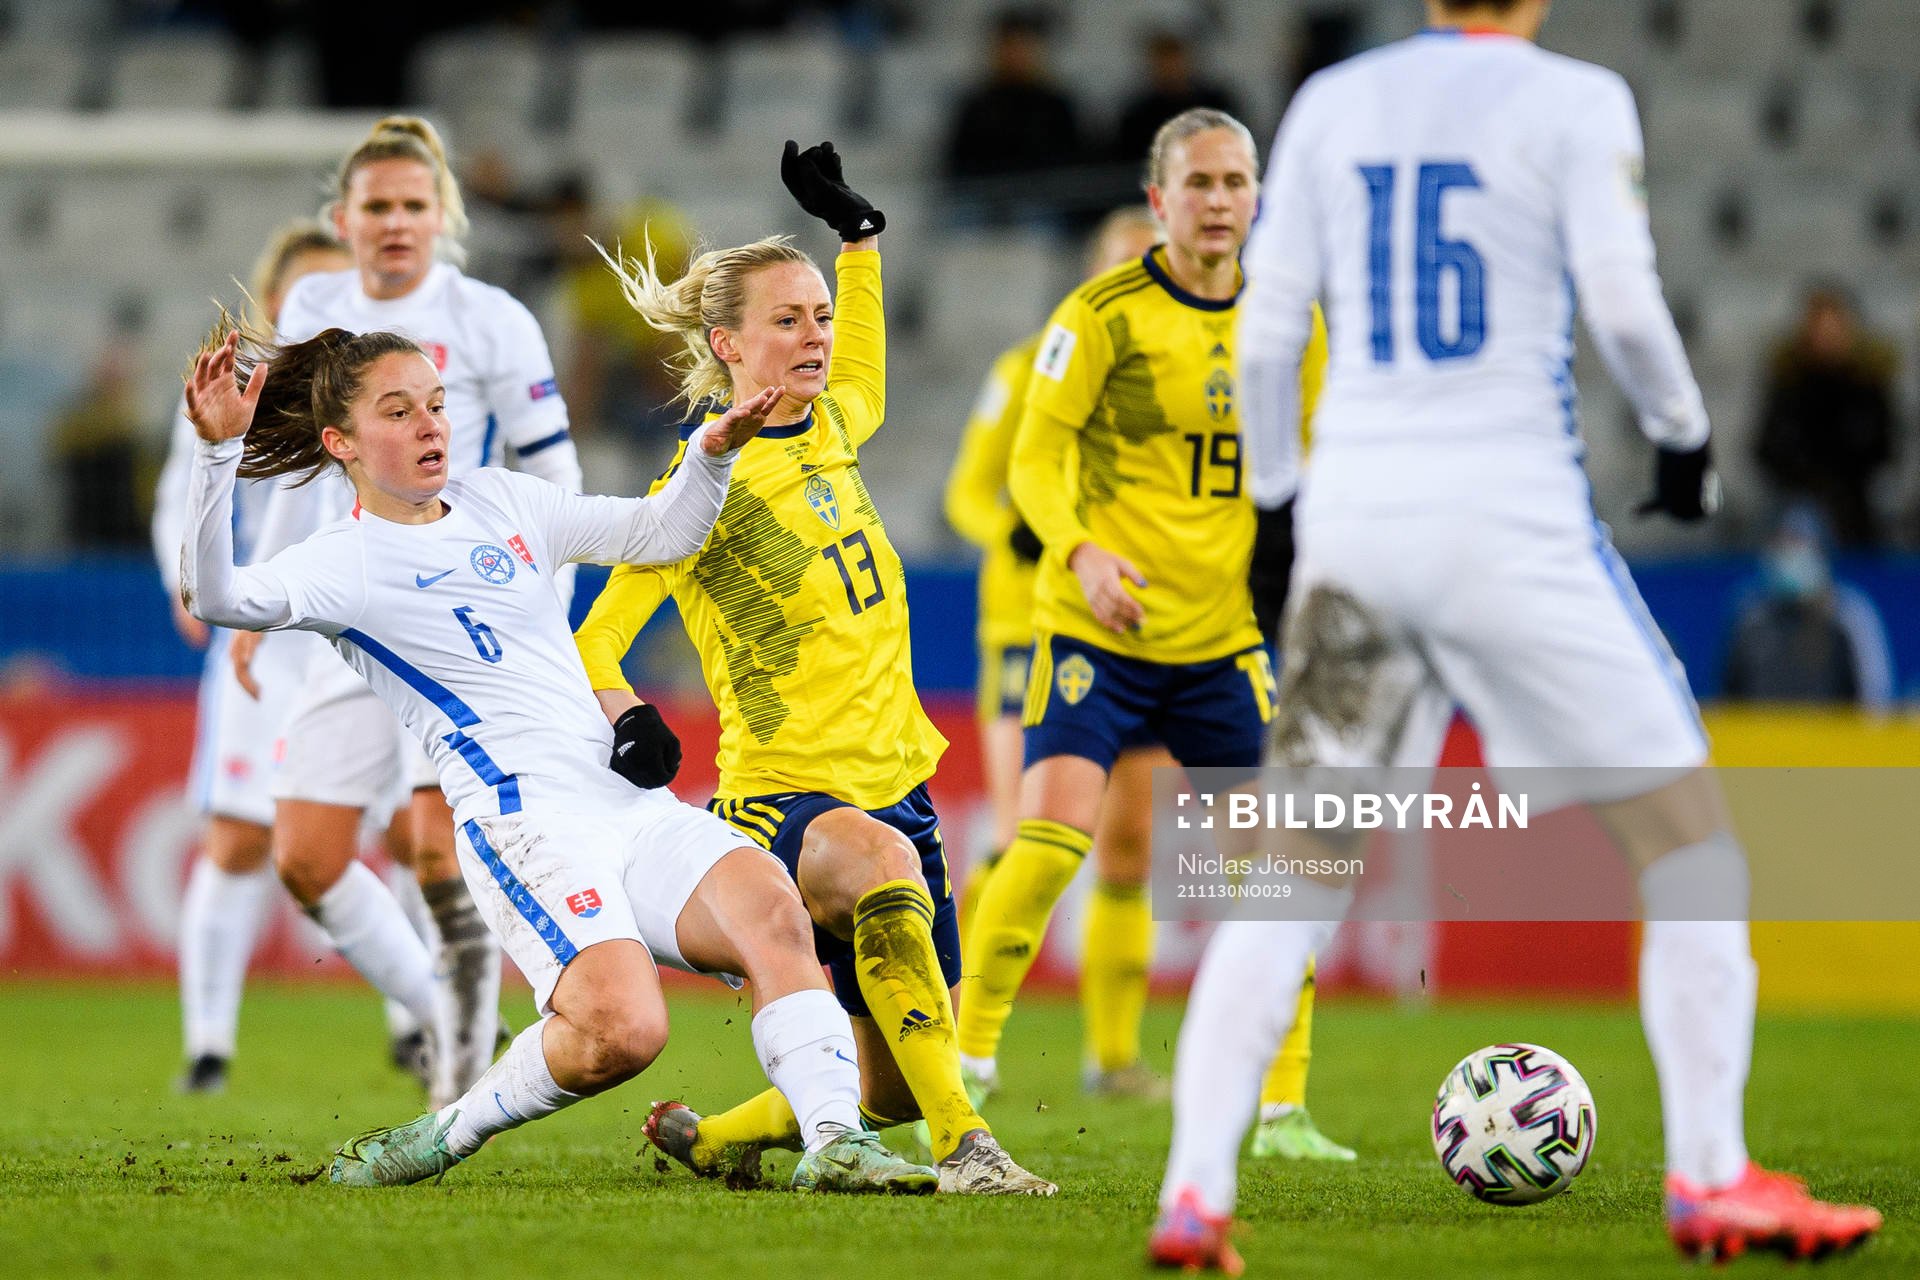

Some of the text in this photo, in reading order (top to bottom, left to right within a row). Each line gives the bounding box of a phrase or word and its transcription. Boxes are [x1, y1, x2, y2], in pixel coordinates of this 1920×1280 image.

[1356, 163, 1484, 362] 16
[1184, 433, 1243, 498] 19
[821, 529, 885, 616] 13
[452, 605, 503, 663] 6
[899, 1019, 942, 1042] adidas
